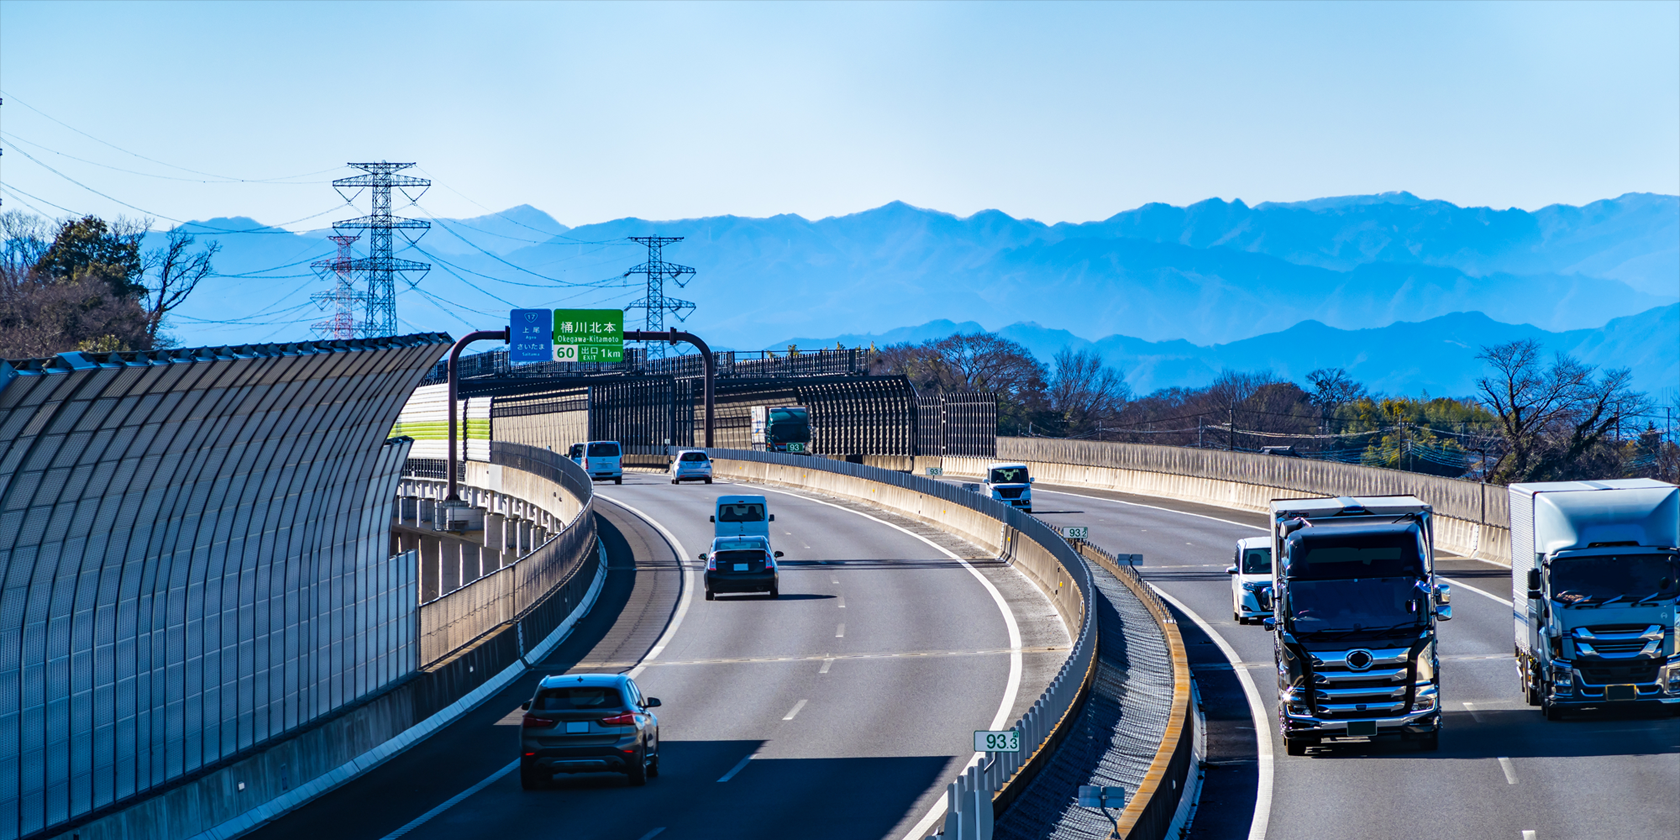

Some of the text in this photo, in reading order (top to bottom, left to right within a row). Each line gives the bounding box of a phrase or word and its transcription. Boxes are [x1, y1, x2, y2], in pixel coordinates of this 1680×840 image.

[522, 326, 540, 334] 上尾
[560, 321, 616, 333] 桶川北本
[557, 335, 619, 344] Okegawa-Kitamoto
[556, 347, 575, 359] 60
[581, 347, 599, 355] 出口
[789, 443, 800, 451] 93
[986, 733, 1018, 750] 93.3
